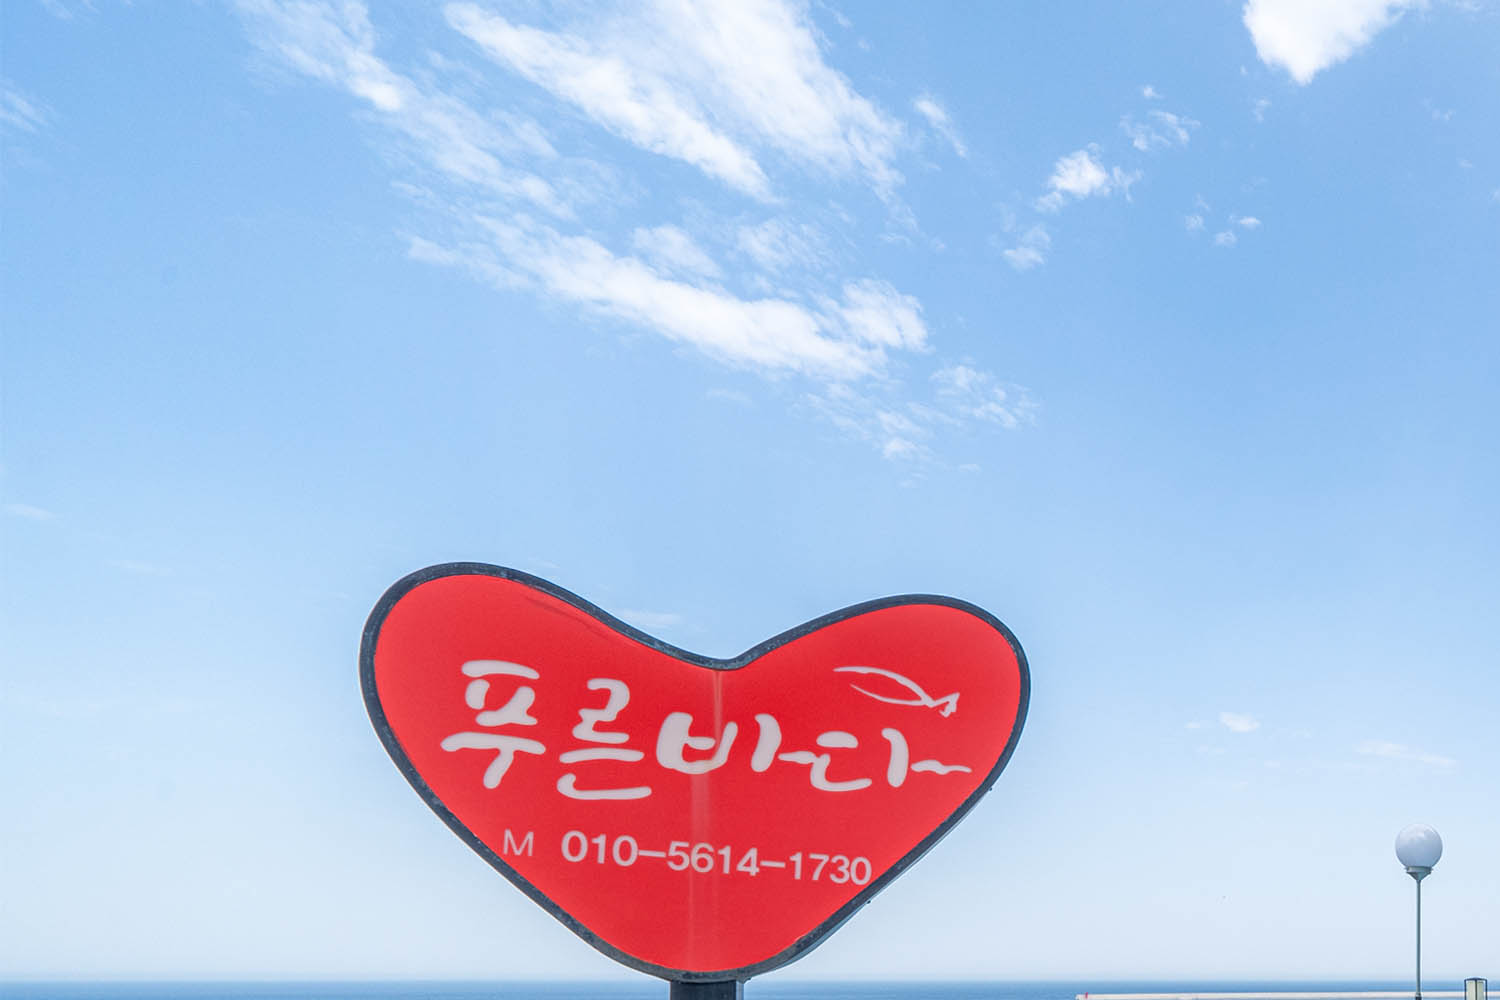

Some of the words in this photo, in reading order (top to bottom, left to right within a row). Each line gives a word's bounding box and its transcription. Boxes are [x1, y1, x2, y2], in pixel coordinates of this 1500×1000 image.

[440, 659, 972, 799] 푸른바다
[502, 830, 534, 858] M
[560, 830, 873, 886] 010-5614-1730
